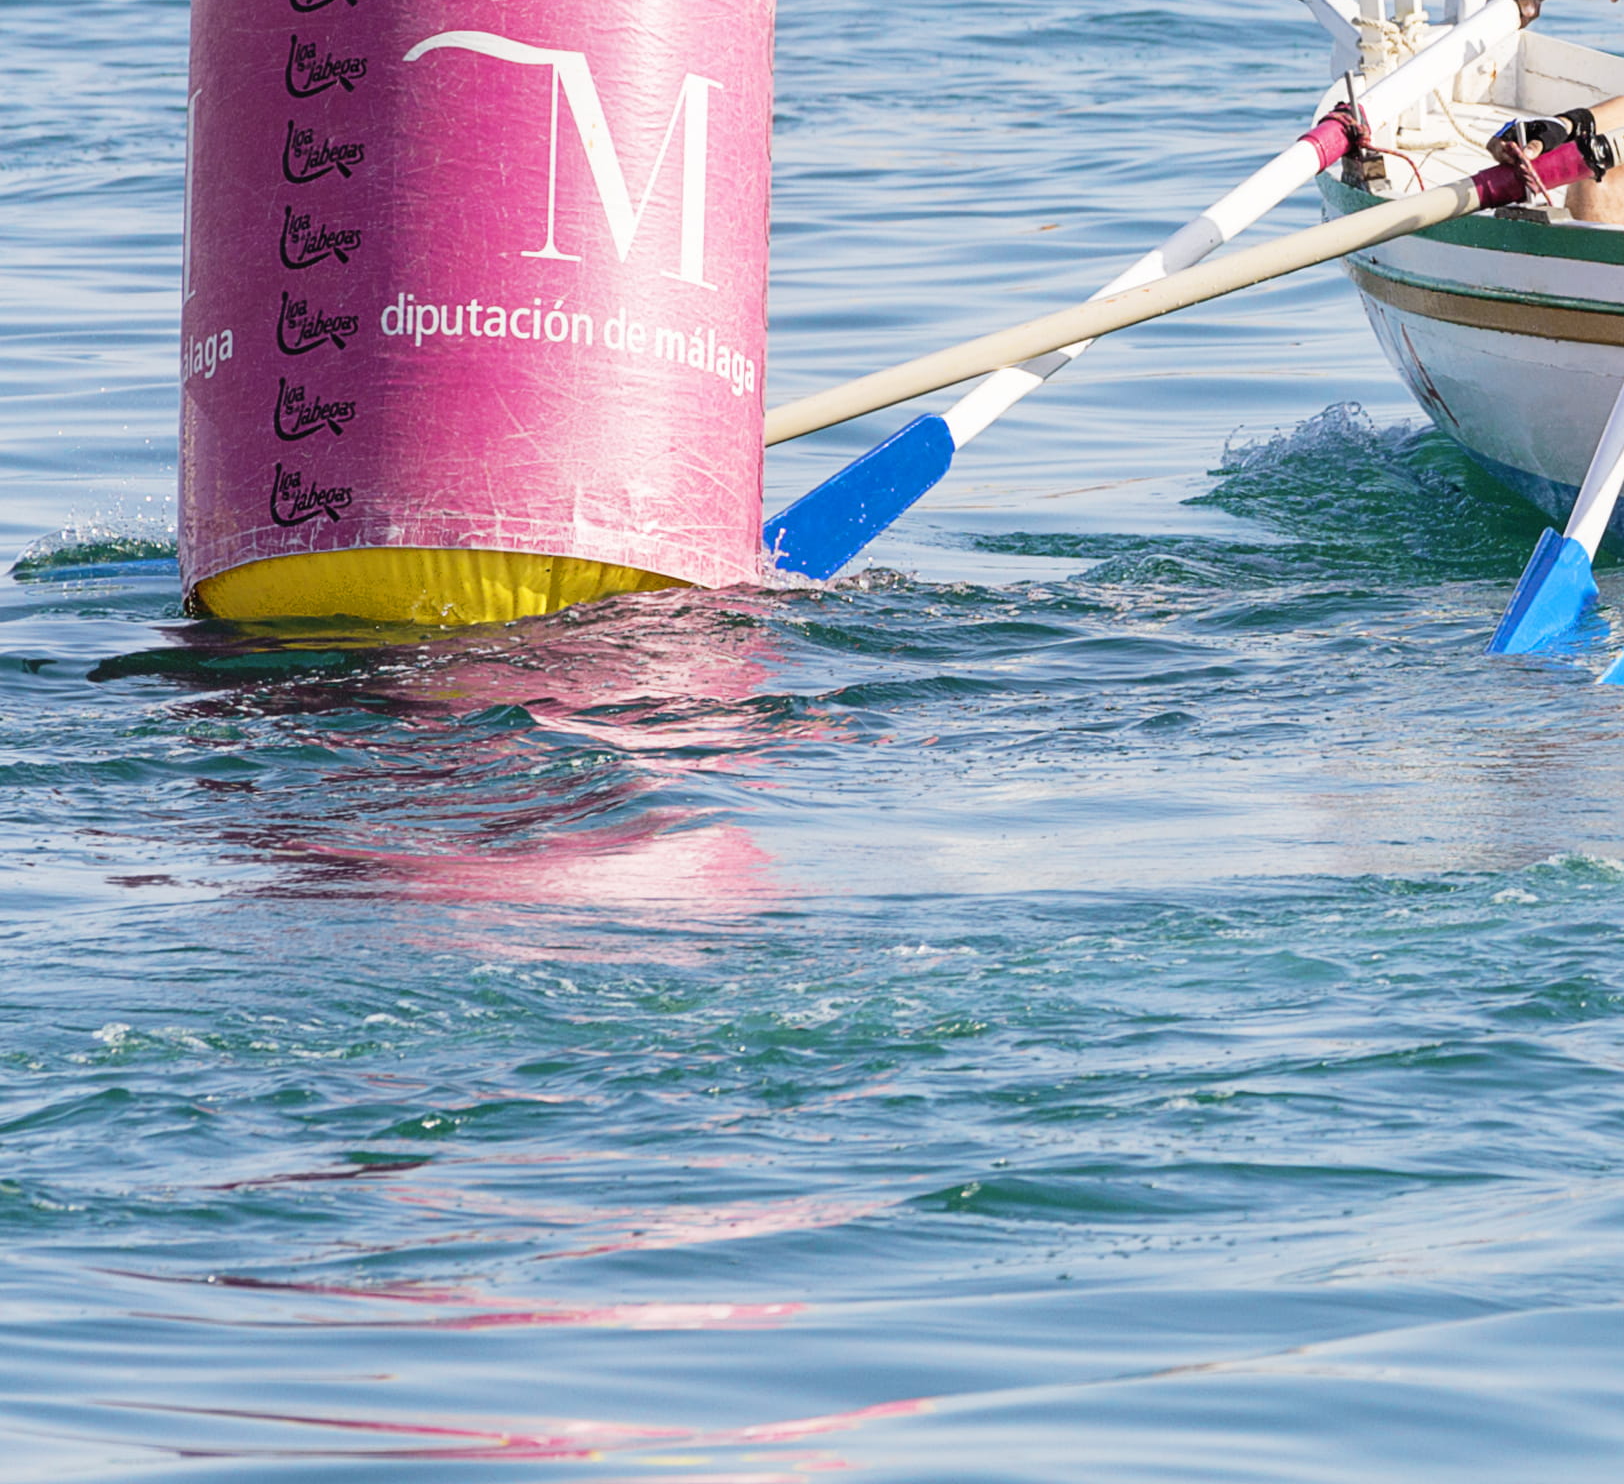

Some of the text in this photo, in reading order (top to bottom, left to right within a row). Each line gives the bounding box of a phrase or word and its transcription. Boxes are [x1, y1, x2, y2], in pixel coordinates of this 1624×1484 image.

[402, 30, 724, 292] M
[380, 293, 756, 398] diputación de málaga
